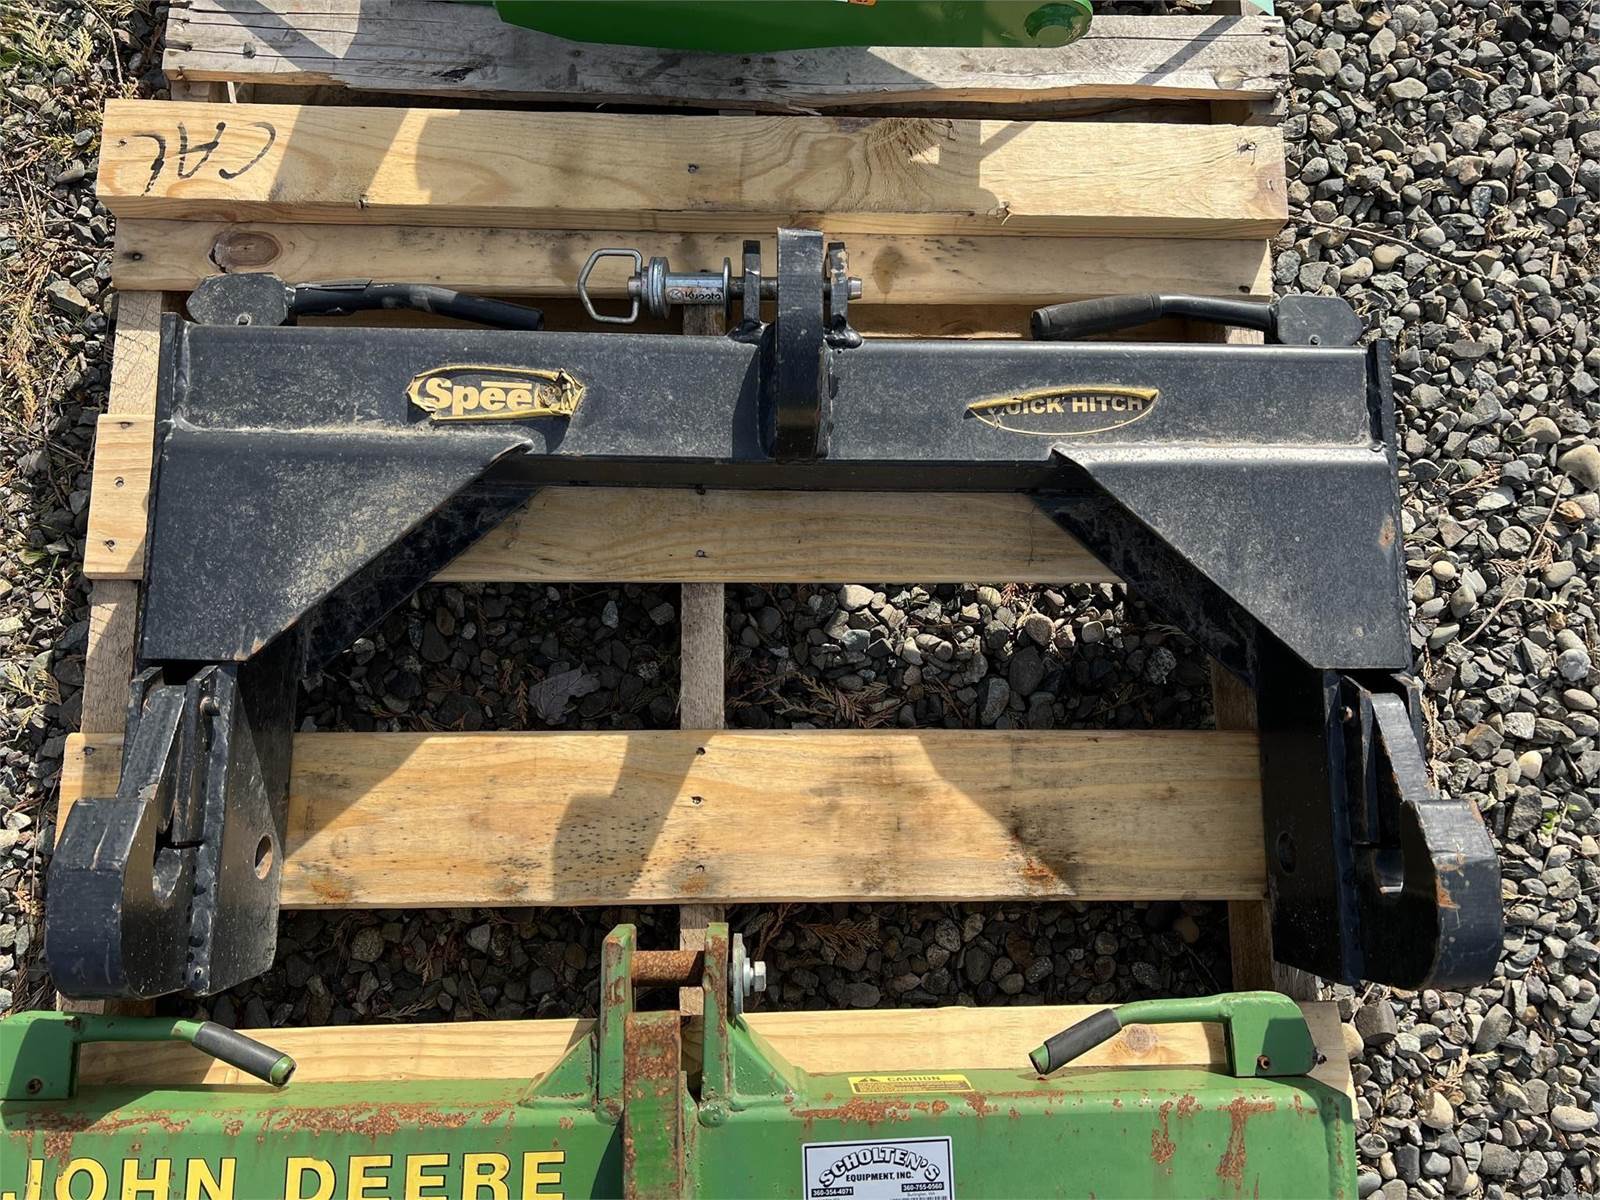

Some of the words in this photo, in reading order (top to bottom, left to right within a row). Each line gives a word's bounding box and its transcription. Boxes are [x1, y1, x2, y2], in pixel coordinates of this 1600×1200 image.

[1072, 396, 1143, 413] HITCH
[0, 1157, 237, 1200] JOHN
[283, 1151, 566, 1200] DEERE
[819, 1147, 940, 1187] SCHOLTEN'S
[846, 1172, 895, 1182] EQUIPMENT,
[896, 1171, 914, 1180] INC.
